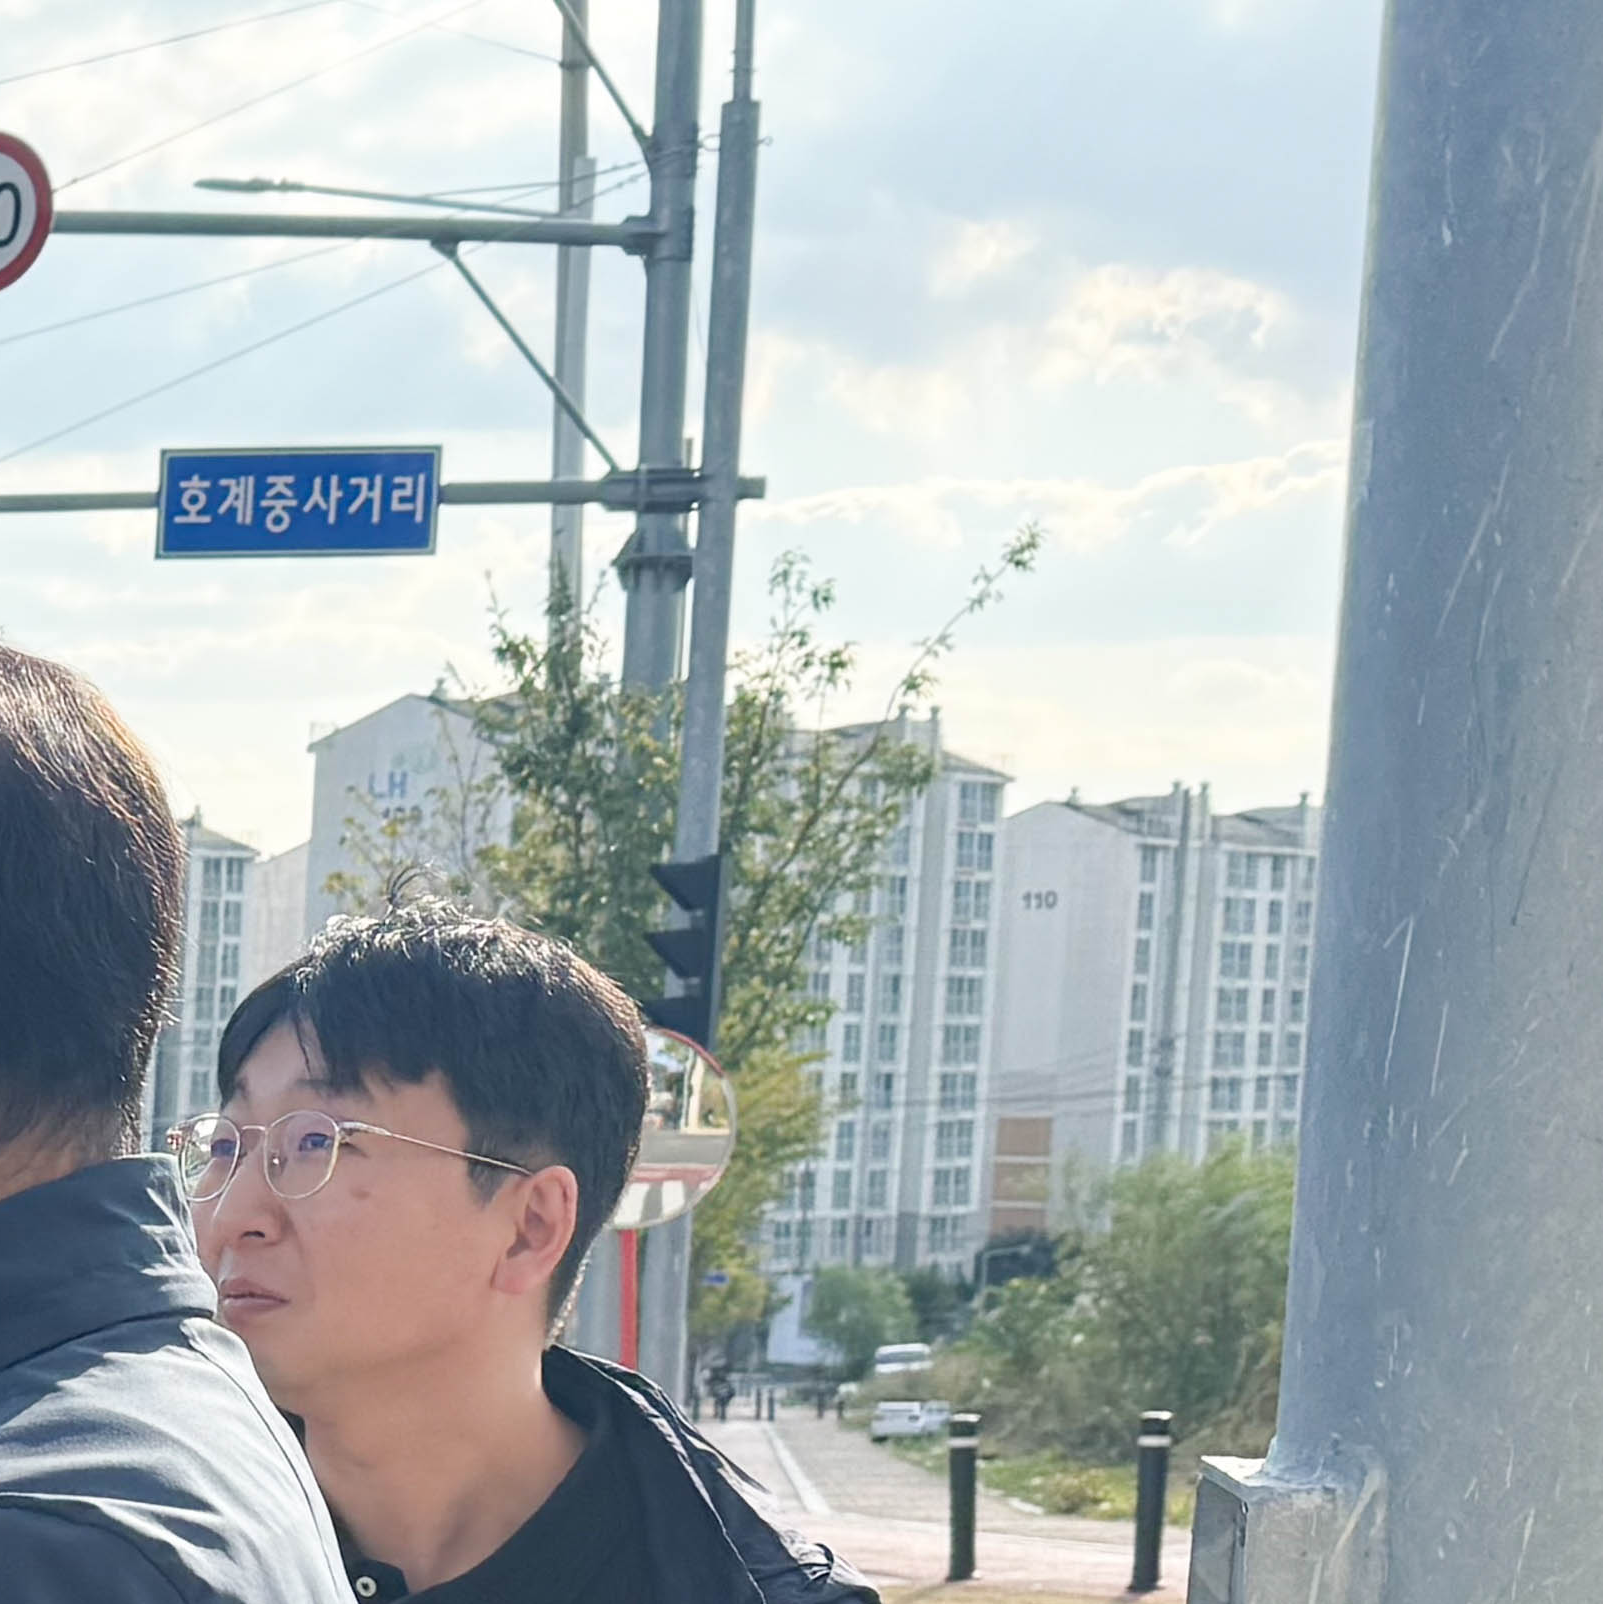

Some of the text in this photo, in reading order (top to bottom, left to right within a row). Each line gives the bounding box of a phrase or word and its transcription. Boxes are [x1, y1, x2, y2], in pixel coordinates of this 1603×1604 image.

[173, 473, 427, 534] 호계중사거리
[368, 770, 408, 799] LH
[1022, 889, 1059, 910] 110
